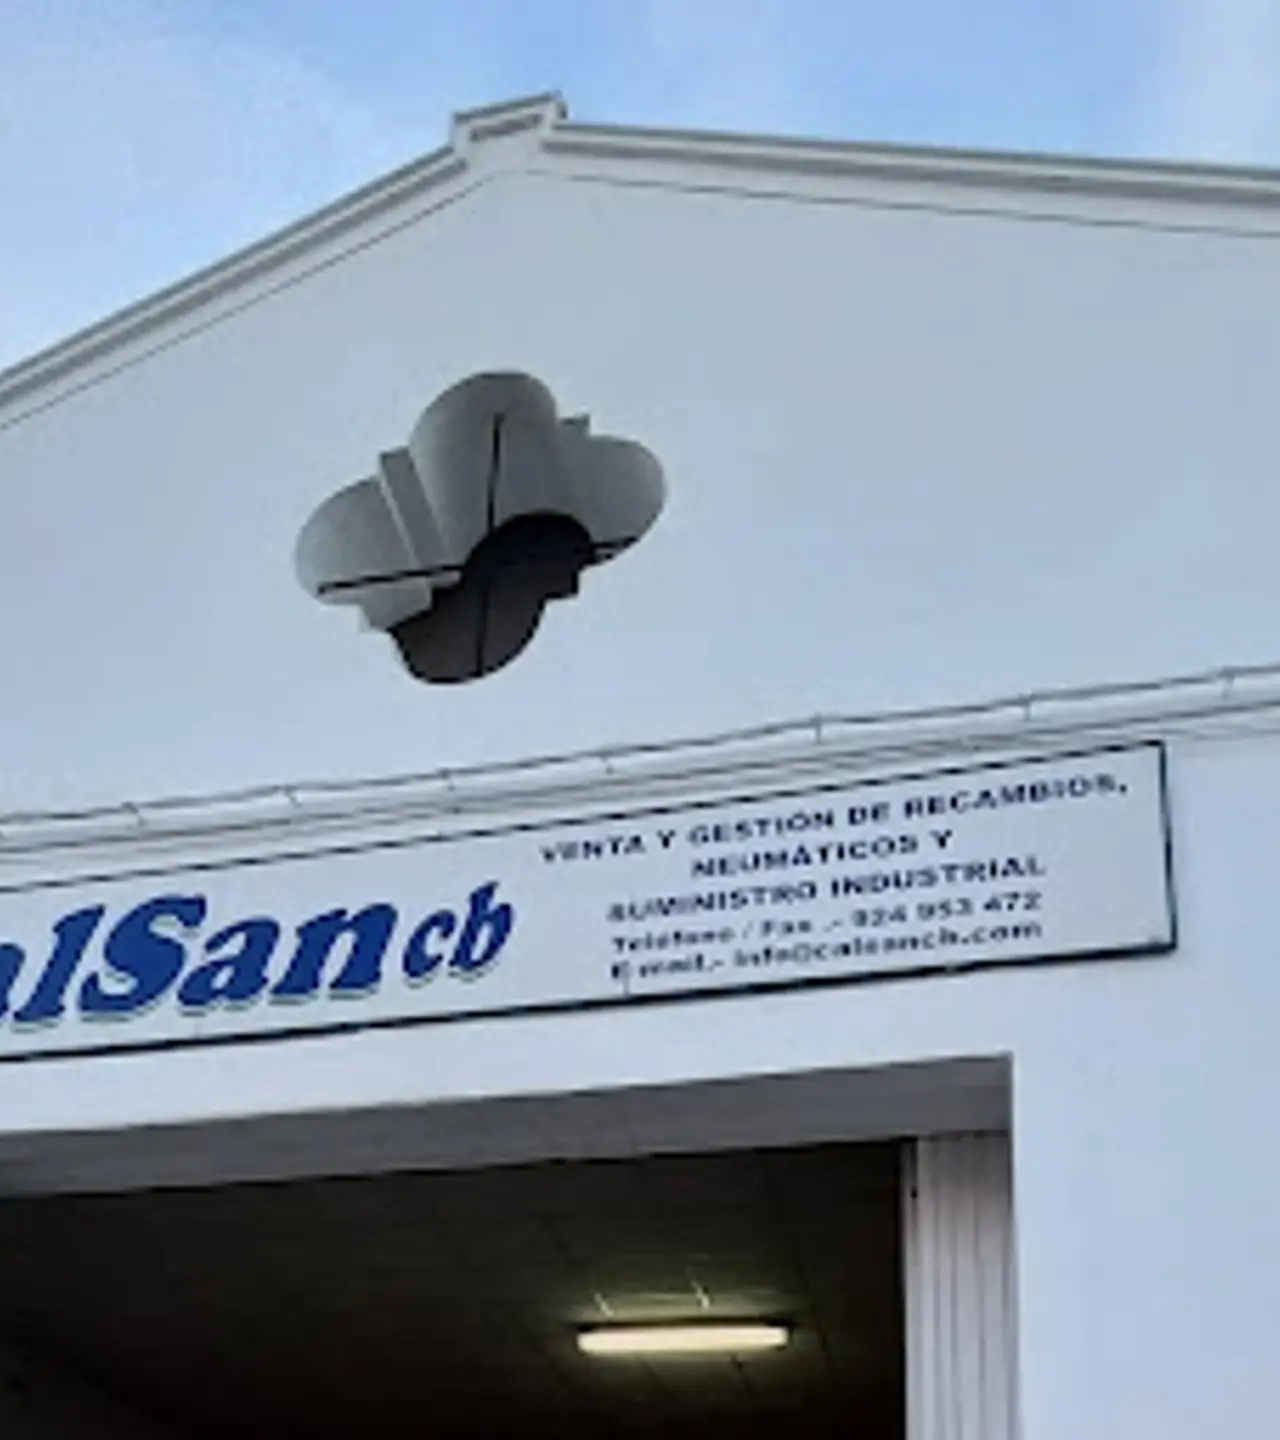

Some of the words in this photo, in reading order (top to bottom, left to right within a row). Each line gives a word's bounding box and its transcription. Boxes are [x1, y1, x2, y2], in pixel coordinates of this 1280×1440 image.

[540, 835, 646, 863] VENTA
[657, 829, 675, 849] Y
[847, 801, 892, 827] DE
[929, 829, 954, 850] Y
[607, 879, 818, 923] SUMINISTRO
[830, 854, 1047, 898] INDUSTRIAL
